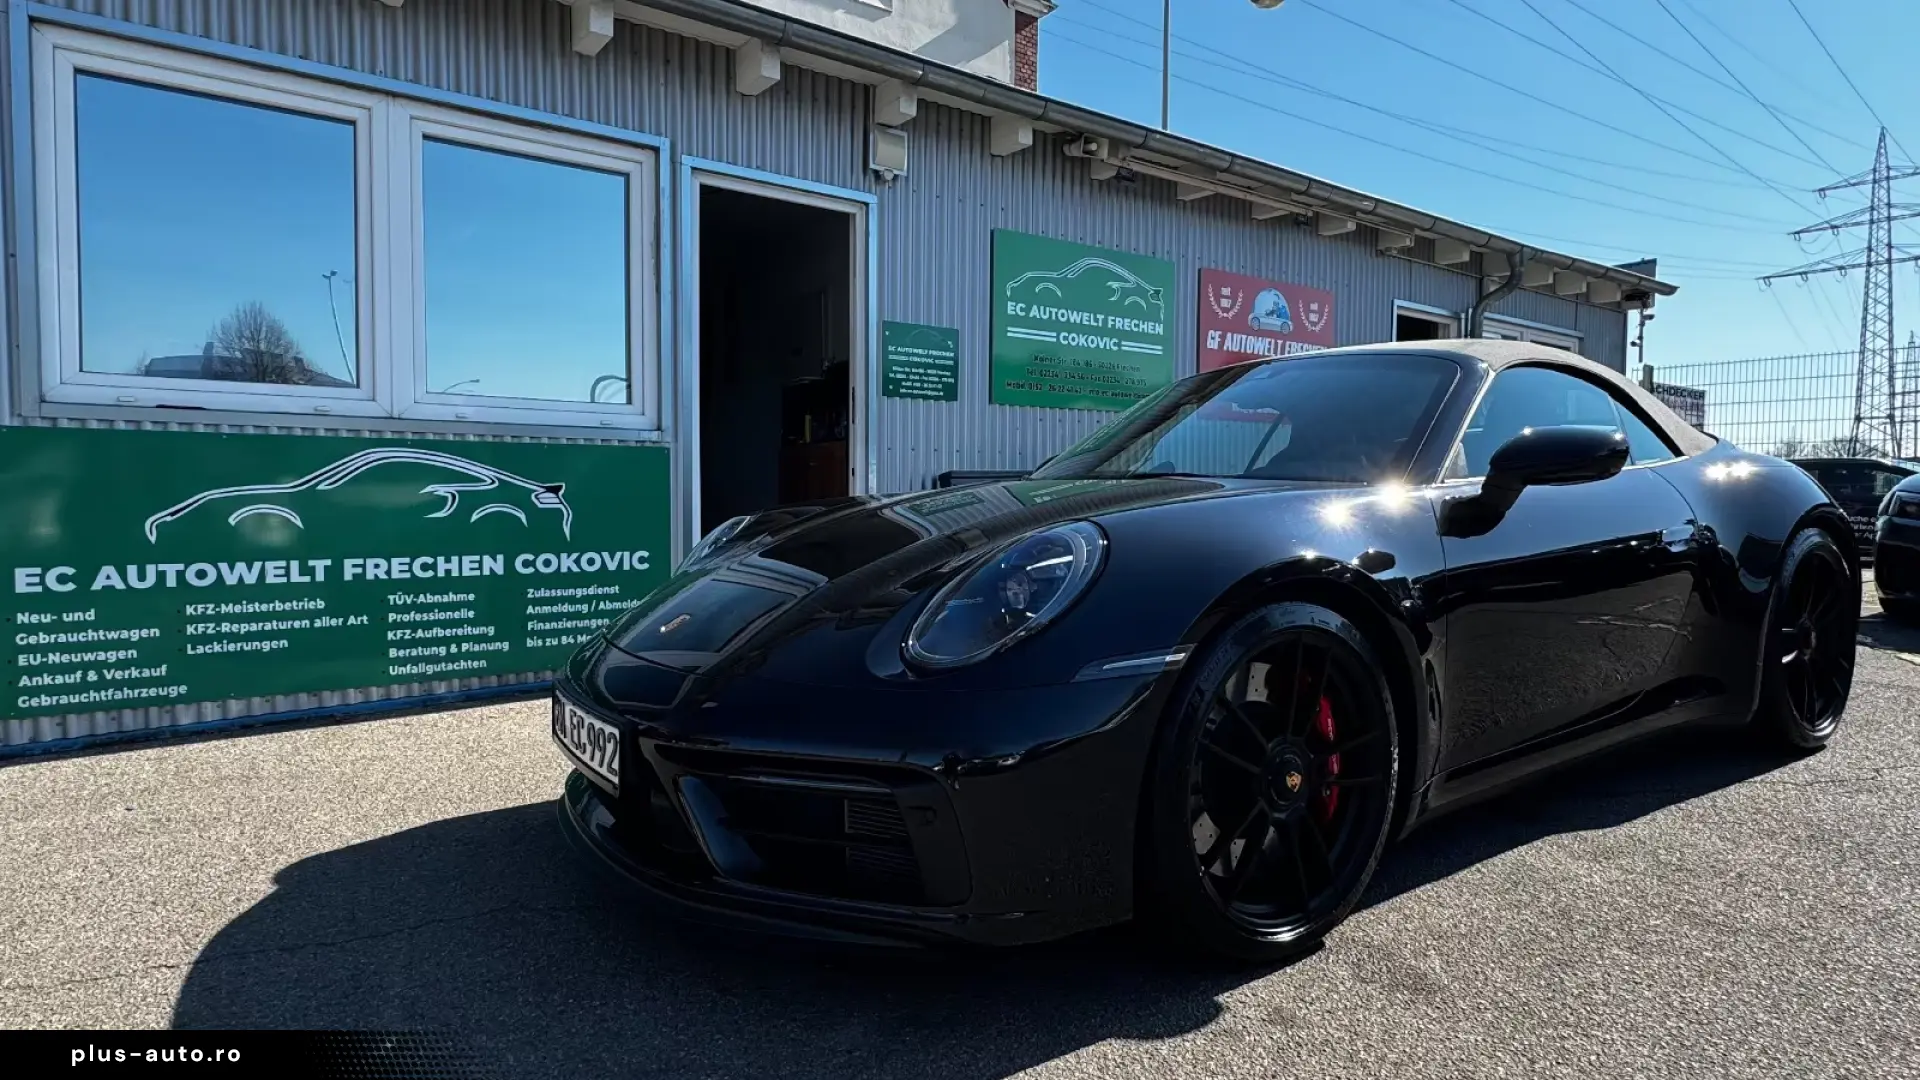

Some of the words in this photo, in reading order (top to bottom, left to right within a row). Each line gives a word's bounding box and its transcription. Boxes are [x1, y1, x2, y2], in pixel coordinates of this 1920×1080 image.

[1007, 301, 1025, 316] EC
[1029, 304, 1104, 328] AUTOWELT
[1107, 315, 1164, 335] FRECHEN
[1059, 331, 1119, 350] COKOVIC
[1206, 330, 1222, 350] GF
[1224, 332, 1283, 356] AUTOWELT
[14, 566, 77, 593] EC
[90, 558, 332, 591] AUTOWELT
[343, 554, 504, 581] FRECHEN
[514, 550, 650, 575] COKOVIC
[387, 591, 476, 606] TÜV-Abnahme
[526, 584, 620, 598] Zulassungsdienst
[186, 598, 326, 616] KFZ-Meisterbetrieb
[388, 608, 475, 624] Professionelle
[526, 602, 588, 615] Anmeldung
[591, 600, 596, 613] /
[598, 599, 642, 611] Abmeld
[16, 611, 58, 625] Neu-
[63, 608, 96, 623] und
[186, 618, 310, 636] KFZ-Reparaturen
[314, 615, 343, 629] aller
[347, 613, 369, 626] Art
[527, 618, 610, 631] Finanzierungen
[16, 626, 160, 646] Gebrauchtwagen
[387, 624, 495, 642] KFZ-Aufbereitung
[526, 636, 543, 647] bis
[545, 637, 559, 646] zu
[561, 635, 575, 645] 84
[186, 637, 289, 655] Lackierungen
[389, 643, 447, 659] Beratung
[450, 643, 458, 654] &
[461, 639, 510, 654] Planung
[18, 647, 138, 667] EU-Neuwagen
[18, 670, 82, 688] Ankauf
[87, 669, 98, 683] &
[103, 664, 168, 681] Verkauf
[389, 658, 487, 676] Unfallgutachten
[17, 683, 188, 708] Gebrauchtfahrzeuge
